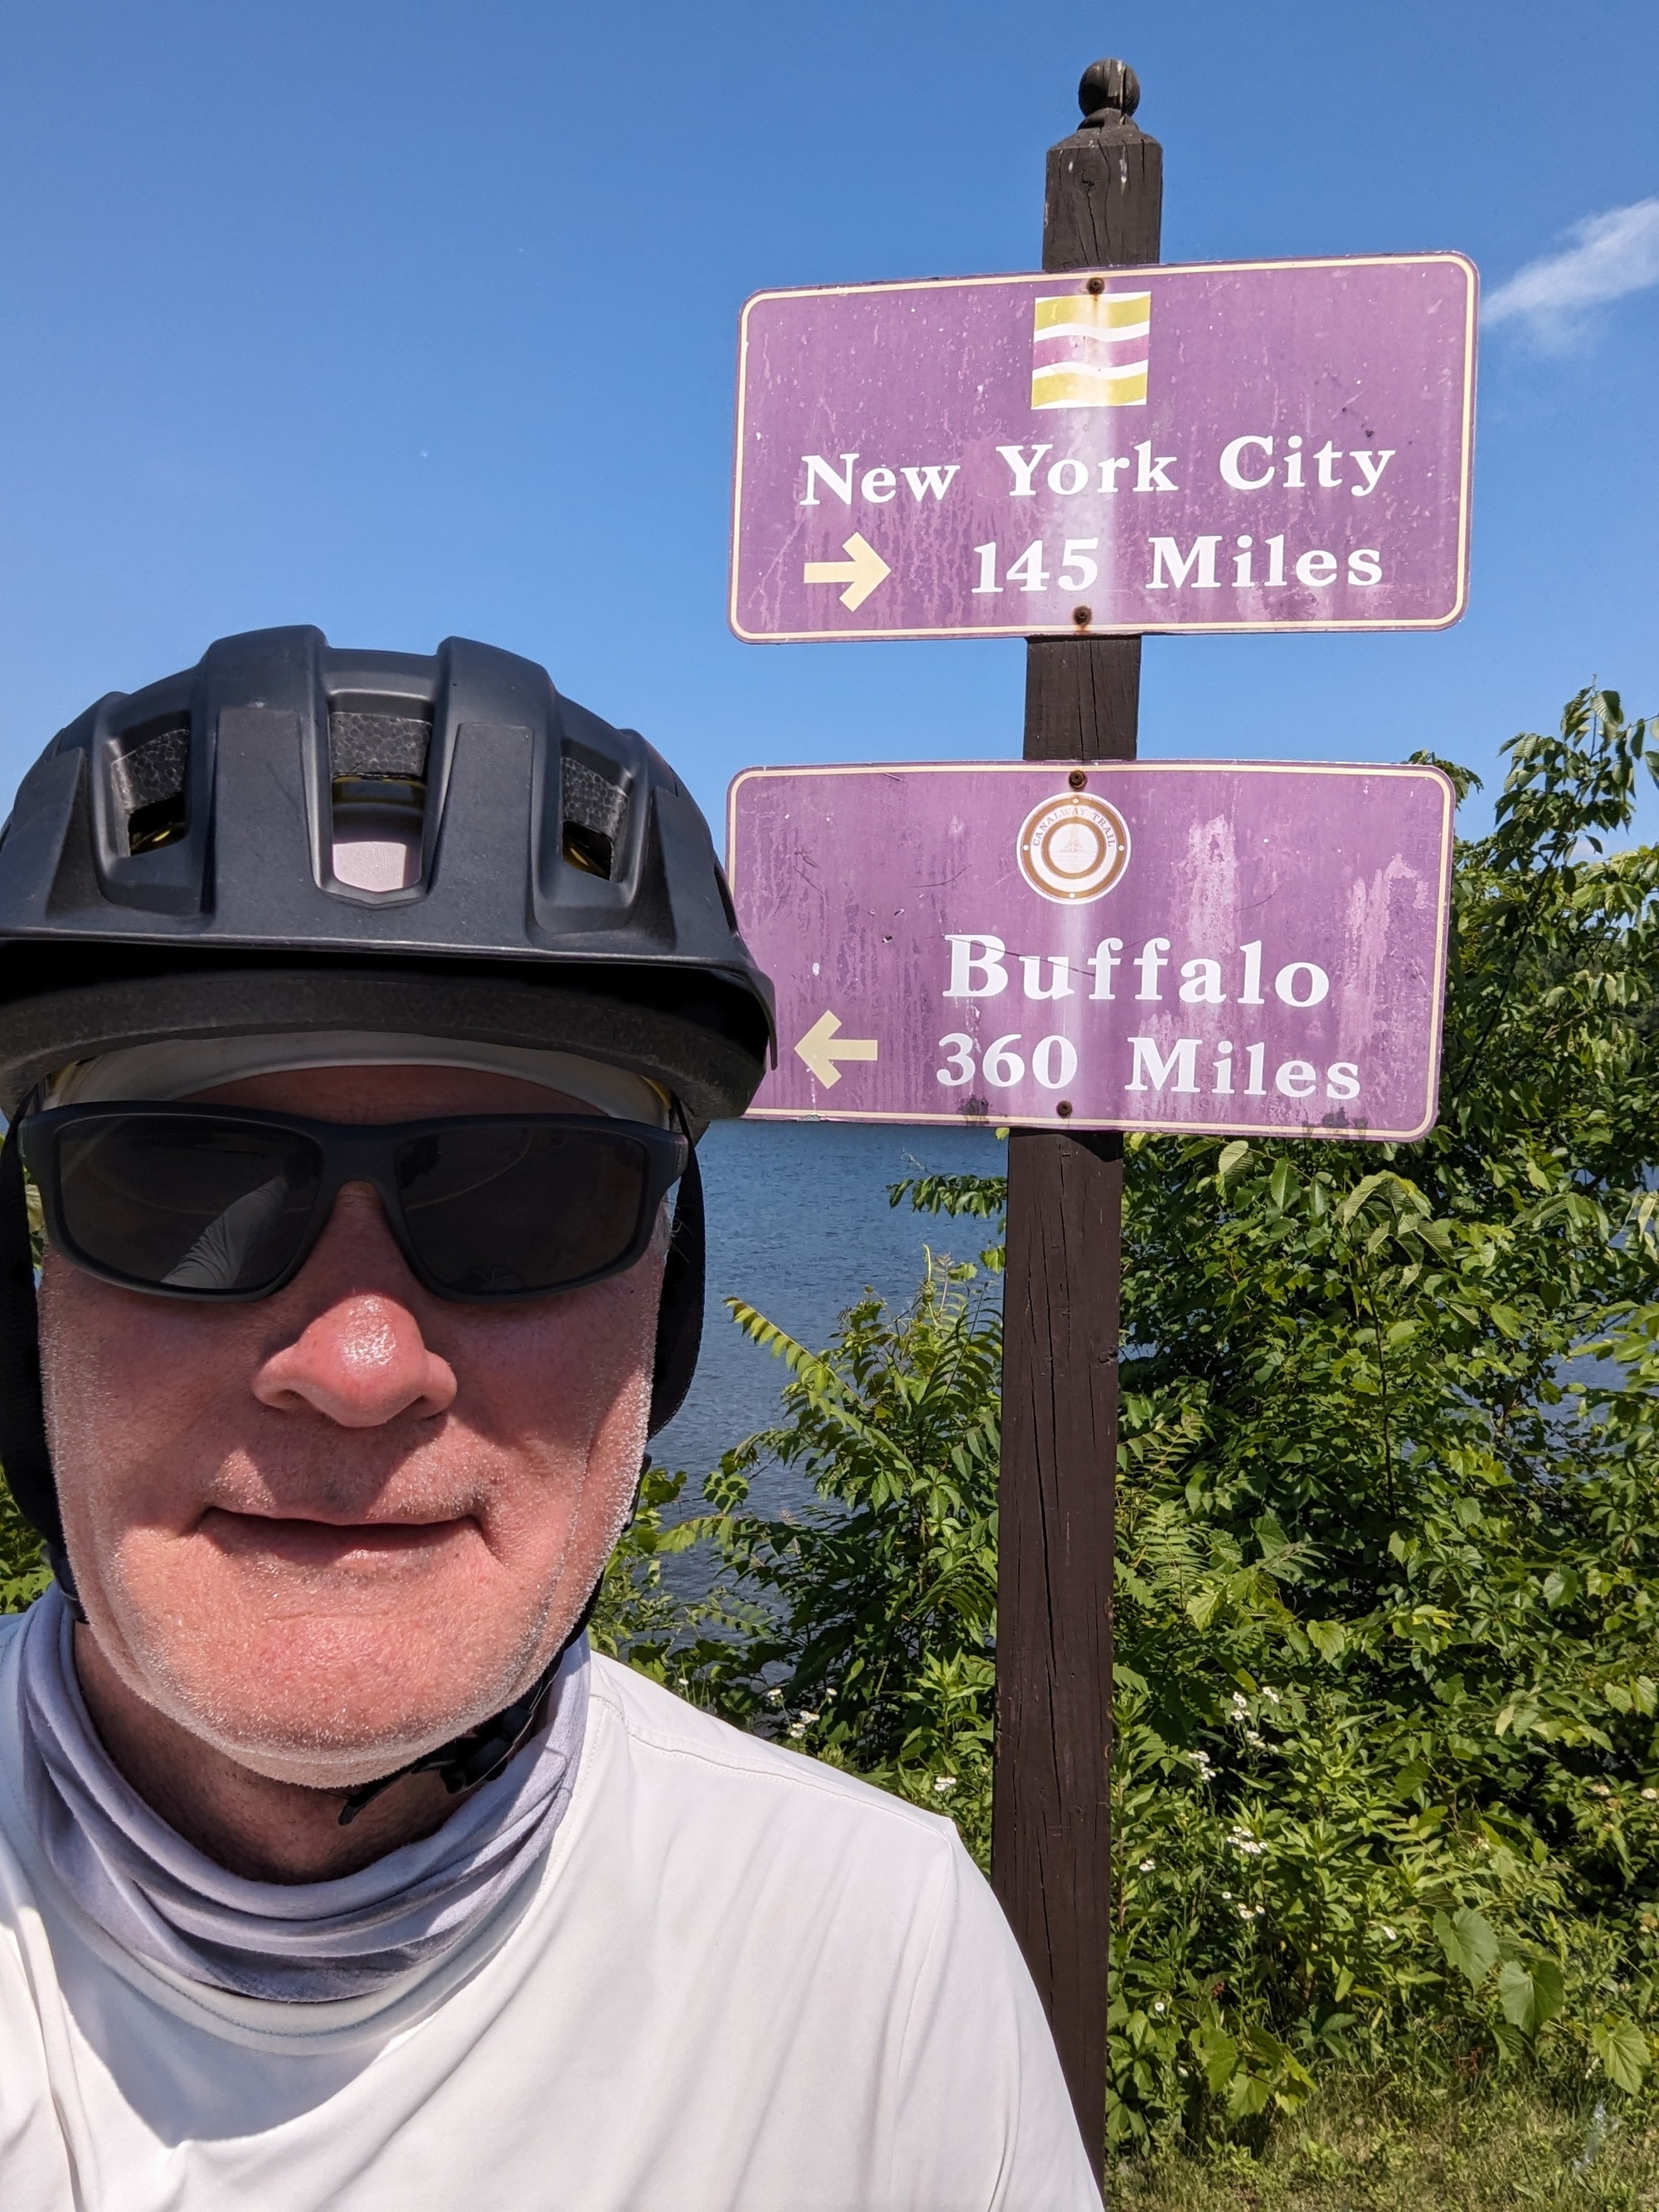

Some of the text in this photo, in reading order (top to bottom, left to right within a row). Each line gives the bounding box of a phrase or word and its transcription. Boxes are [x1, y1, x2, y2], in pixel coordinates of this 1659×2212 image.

[800, 435, 1395, 506] New York City
[972, 535, 1384, 593] 145 Miles
[1033, 807, 1116, 847] CANALWAY TRAIL
[943, 934, 1330, 1008] Buffalo
[937, 1033, 1361, 1099] 360 Miles
